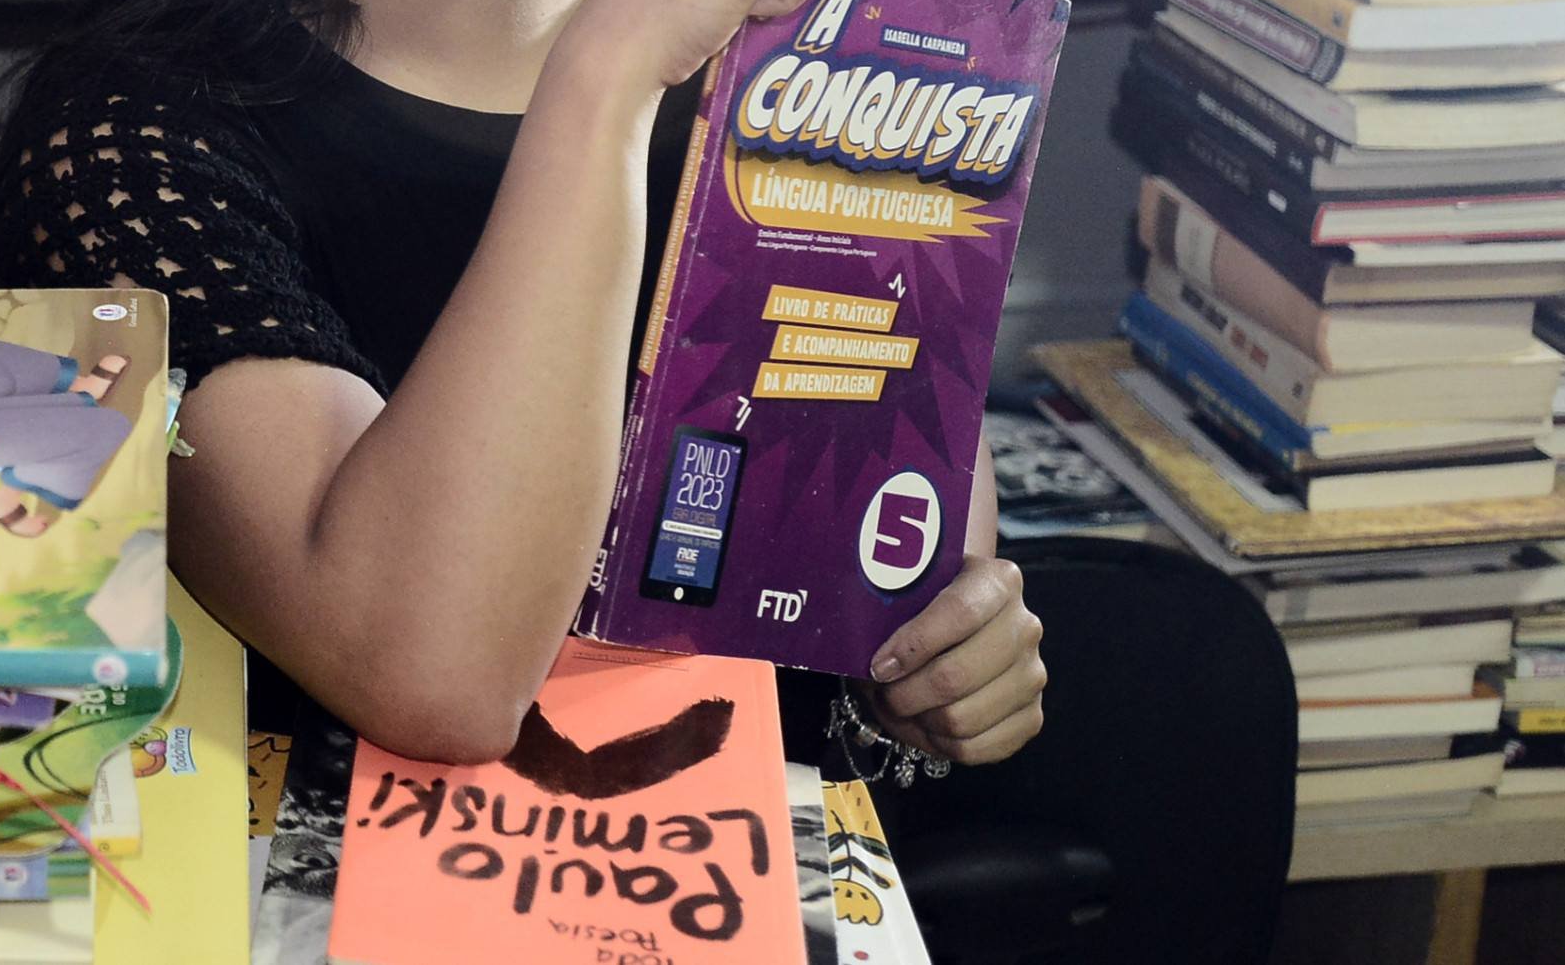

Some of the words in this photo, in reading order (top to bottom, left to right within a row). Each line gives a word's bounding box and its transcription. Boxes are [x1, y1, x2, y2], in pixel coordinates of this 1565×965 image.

[884, 28, 921, 48] ISABELLA
[922, 35, 965, 56] CARPANEDA
[744, 55, 1035, 167] CONQUISTA
[750, 167, 827, 214] LÍNGUA
[832, 183, 955, 228] PORTUGUESA
[773, 296, 809, 318] LIVRO
[813, 301, 830, 319] DE
[833, 301, 890, 325] PRÁTICAS
[782, 334, 791, 352] E
[794, 335, 910, 363] ACOMPANHAMENTO
[763, 372, 780, 392] DA
[784, 372, 876, 395] APRENDIZAGEM
[682, 442, 731, 478] PNLD
[676, 472, 725, 511] 2023
[870, 491, 930, 570] 5
[757, 589, 808, 623] FTD
[357, 771, 769, 876] Leminski
[436, 841, 745, 942] Paulo
[548, 918, 662, 952] Poesia
